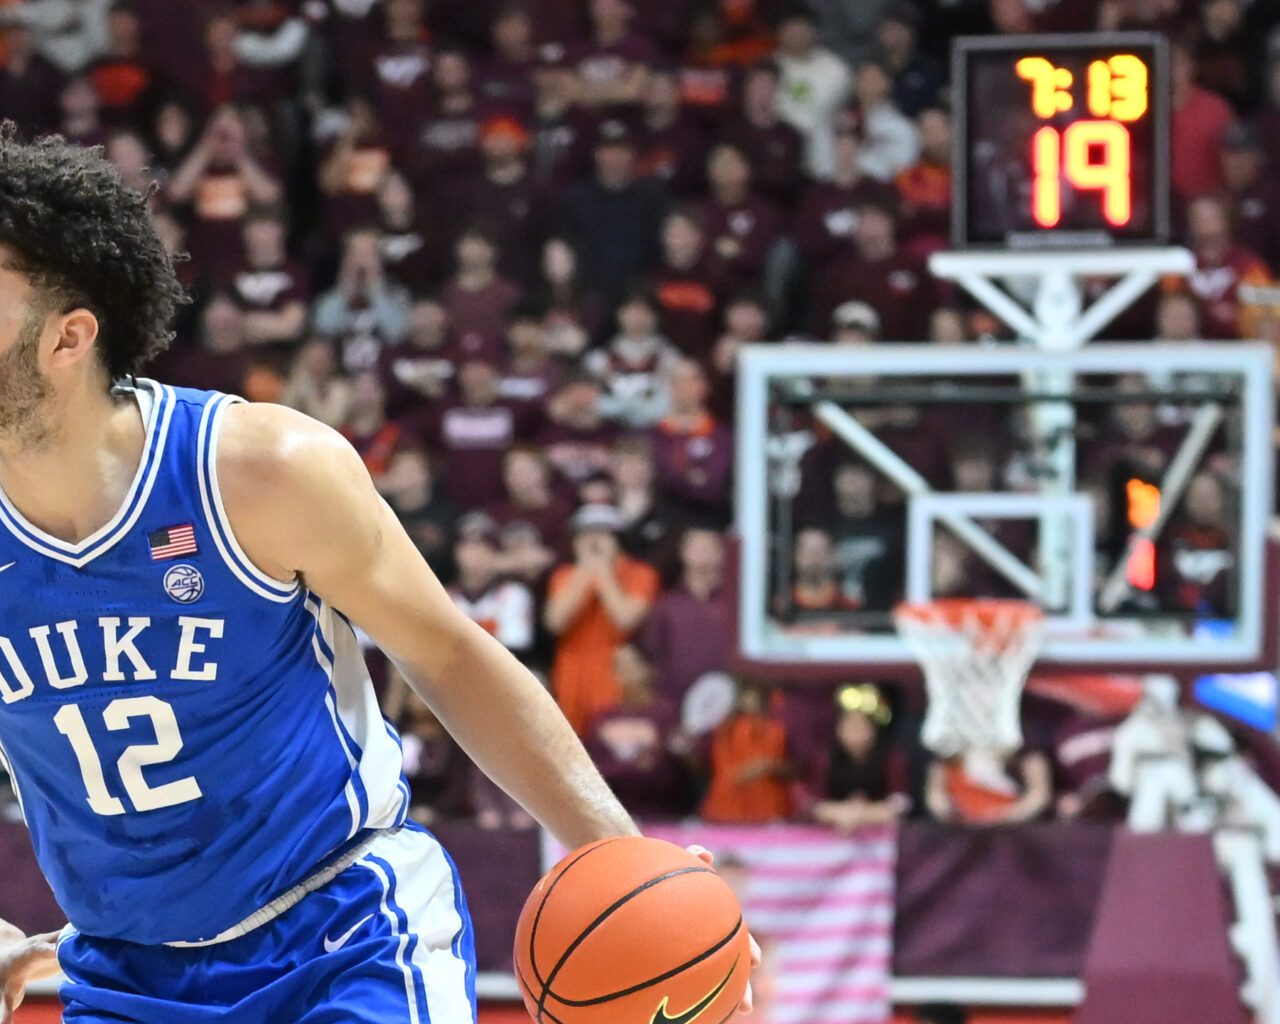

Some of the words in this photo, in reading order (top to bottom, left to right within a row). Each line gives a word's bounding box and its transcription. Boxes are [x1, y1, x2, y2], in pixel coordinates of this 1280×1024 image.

[1016, 55, 1148, 122] 7:13
[1032, 120, 1131, 228] 19
[170, 575, 199, 588] ACC
[54, 695, 203, 816] 12
